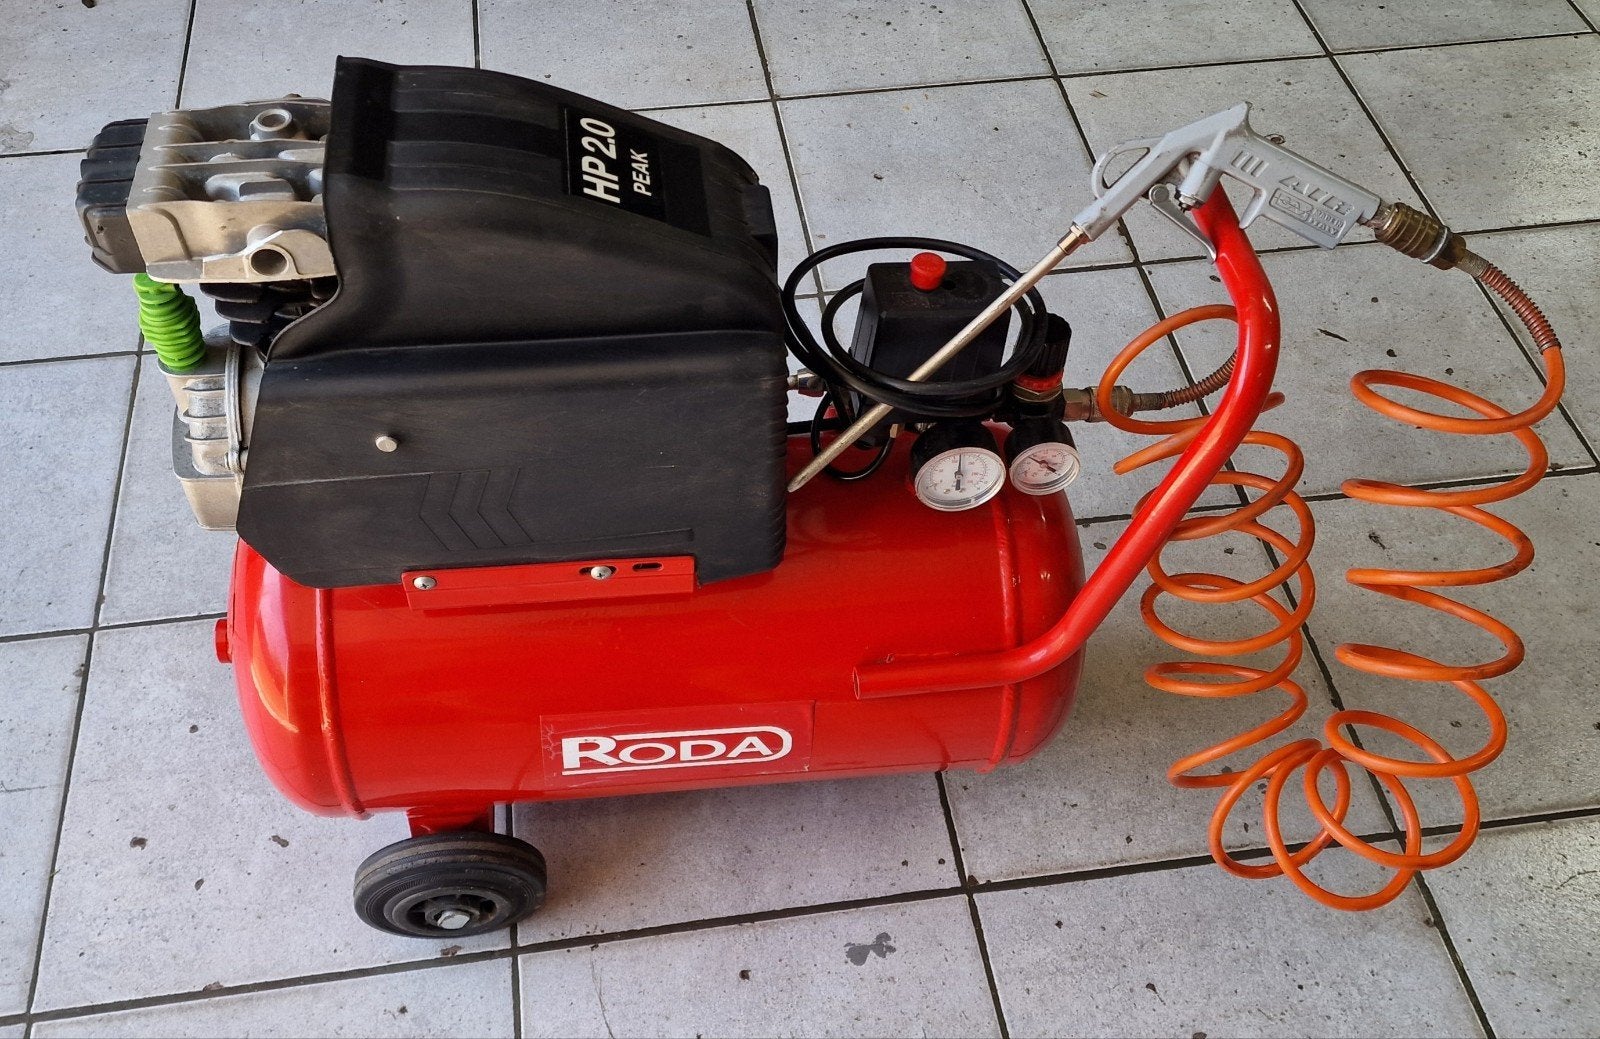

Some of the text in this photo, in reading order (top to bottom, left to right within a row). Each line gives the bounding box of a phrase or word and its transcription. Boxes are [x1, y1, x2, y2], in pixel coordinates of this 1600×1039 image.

[579, 117, 621, 203] HP 2.0
[629, 148, 652, 197] PEAK
[561, 734, 776, 771] RODA
